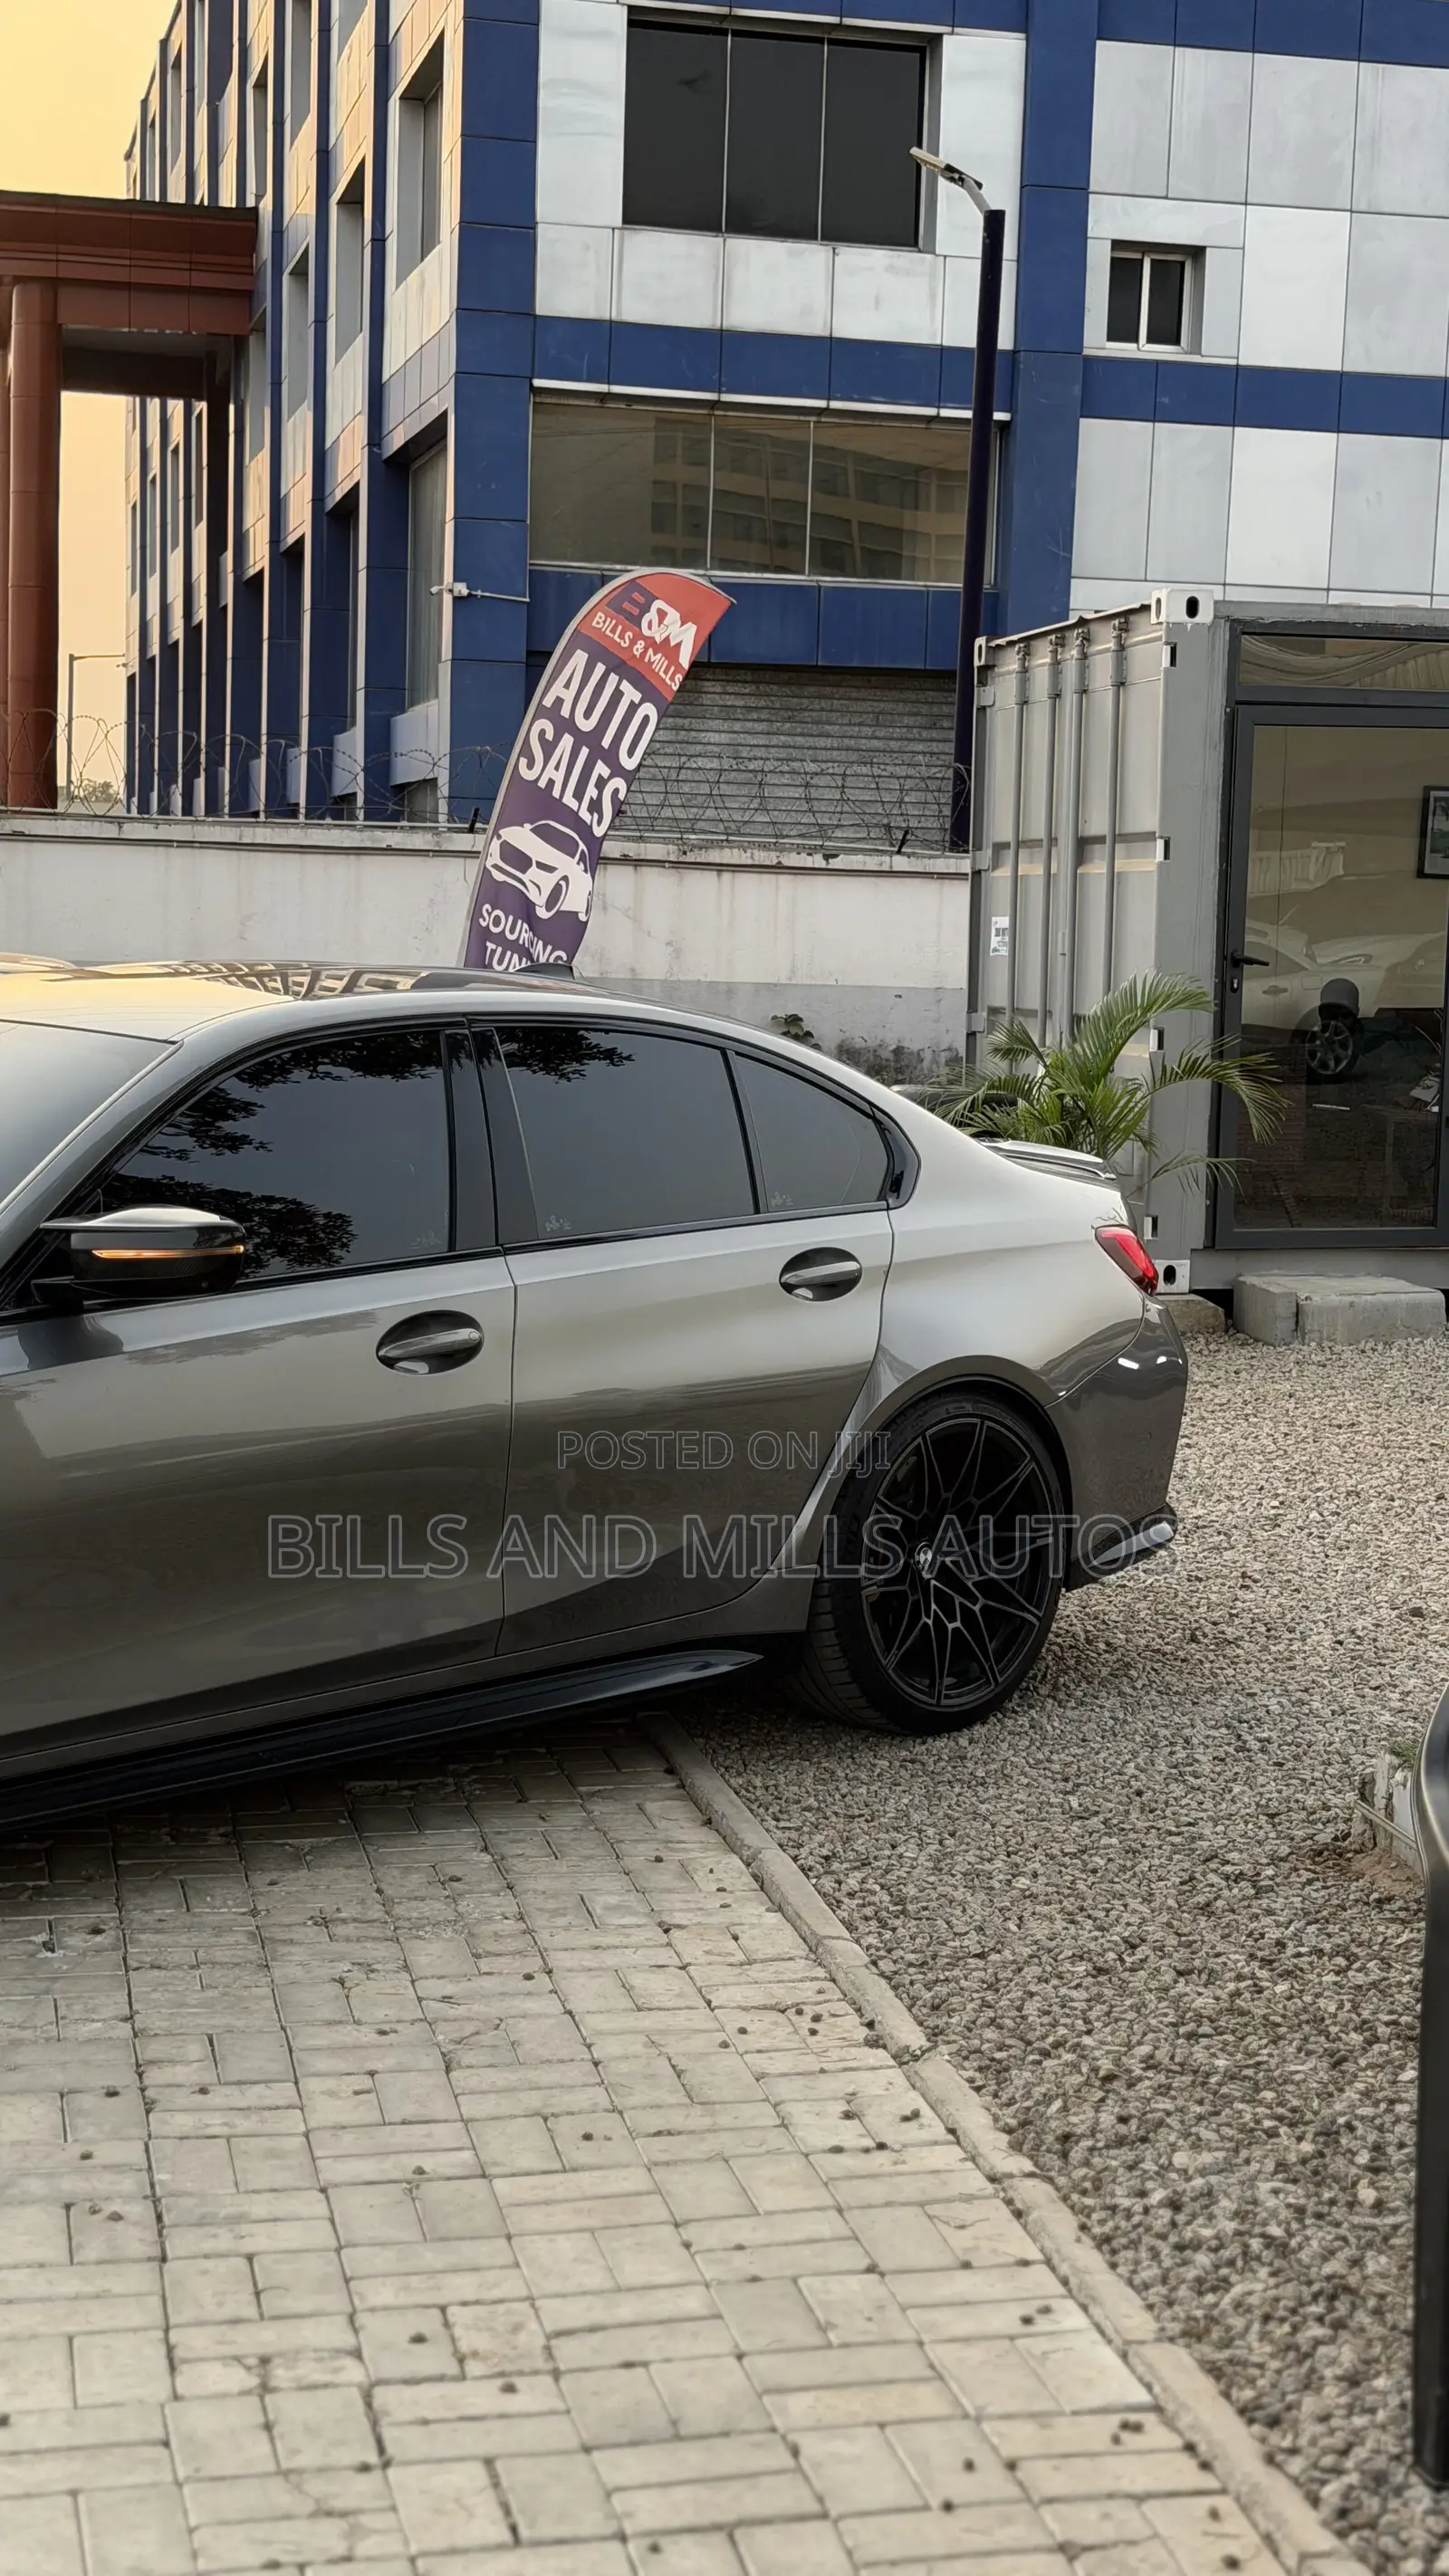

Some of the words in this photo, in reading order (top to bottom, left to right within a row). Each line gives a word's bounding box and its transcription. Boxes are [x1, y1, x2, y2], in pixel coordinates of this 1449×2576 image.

[591, 611, 633, 647] BILLS
[633, 639, 646, 659] &
[644, 647, 684, 692] MILLS
[542, 648, 658, 771] AUTO
[519, 719, 628, 838] SALES
[479, 904, 568, 964] SOURCING
[485, 941, 532, 972] TUN
